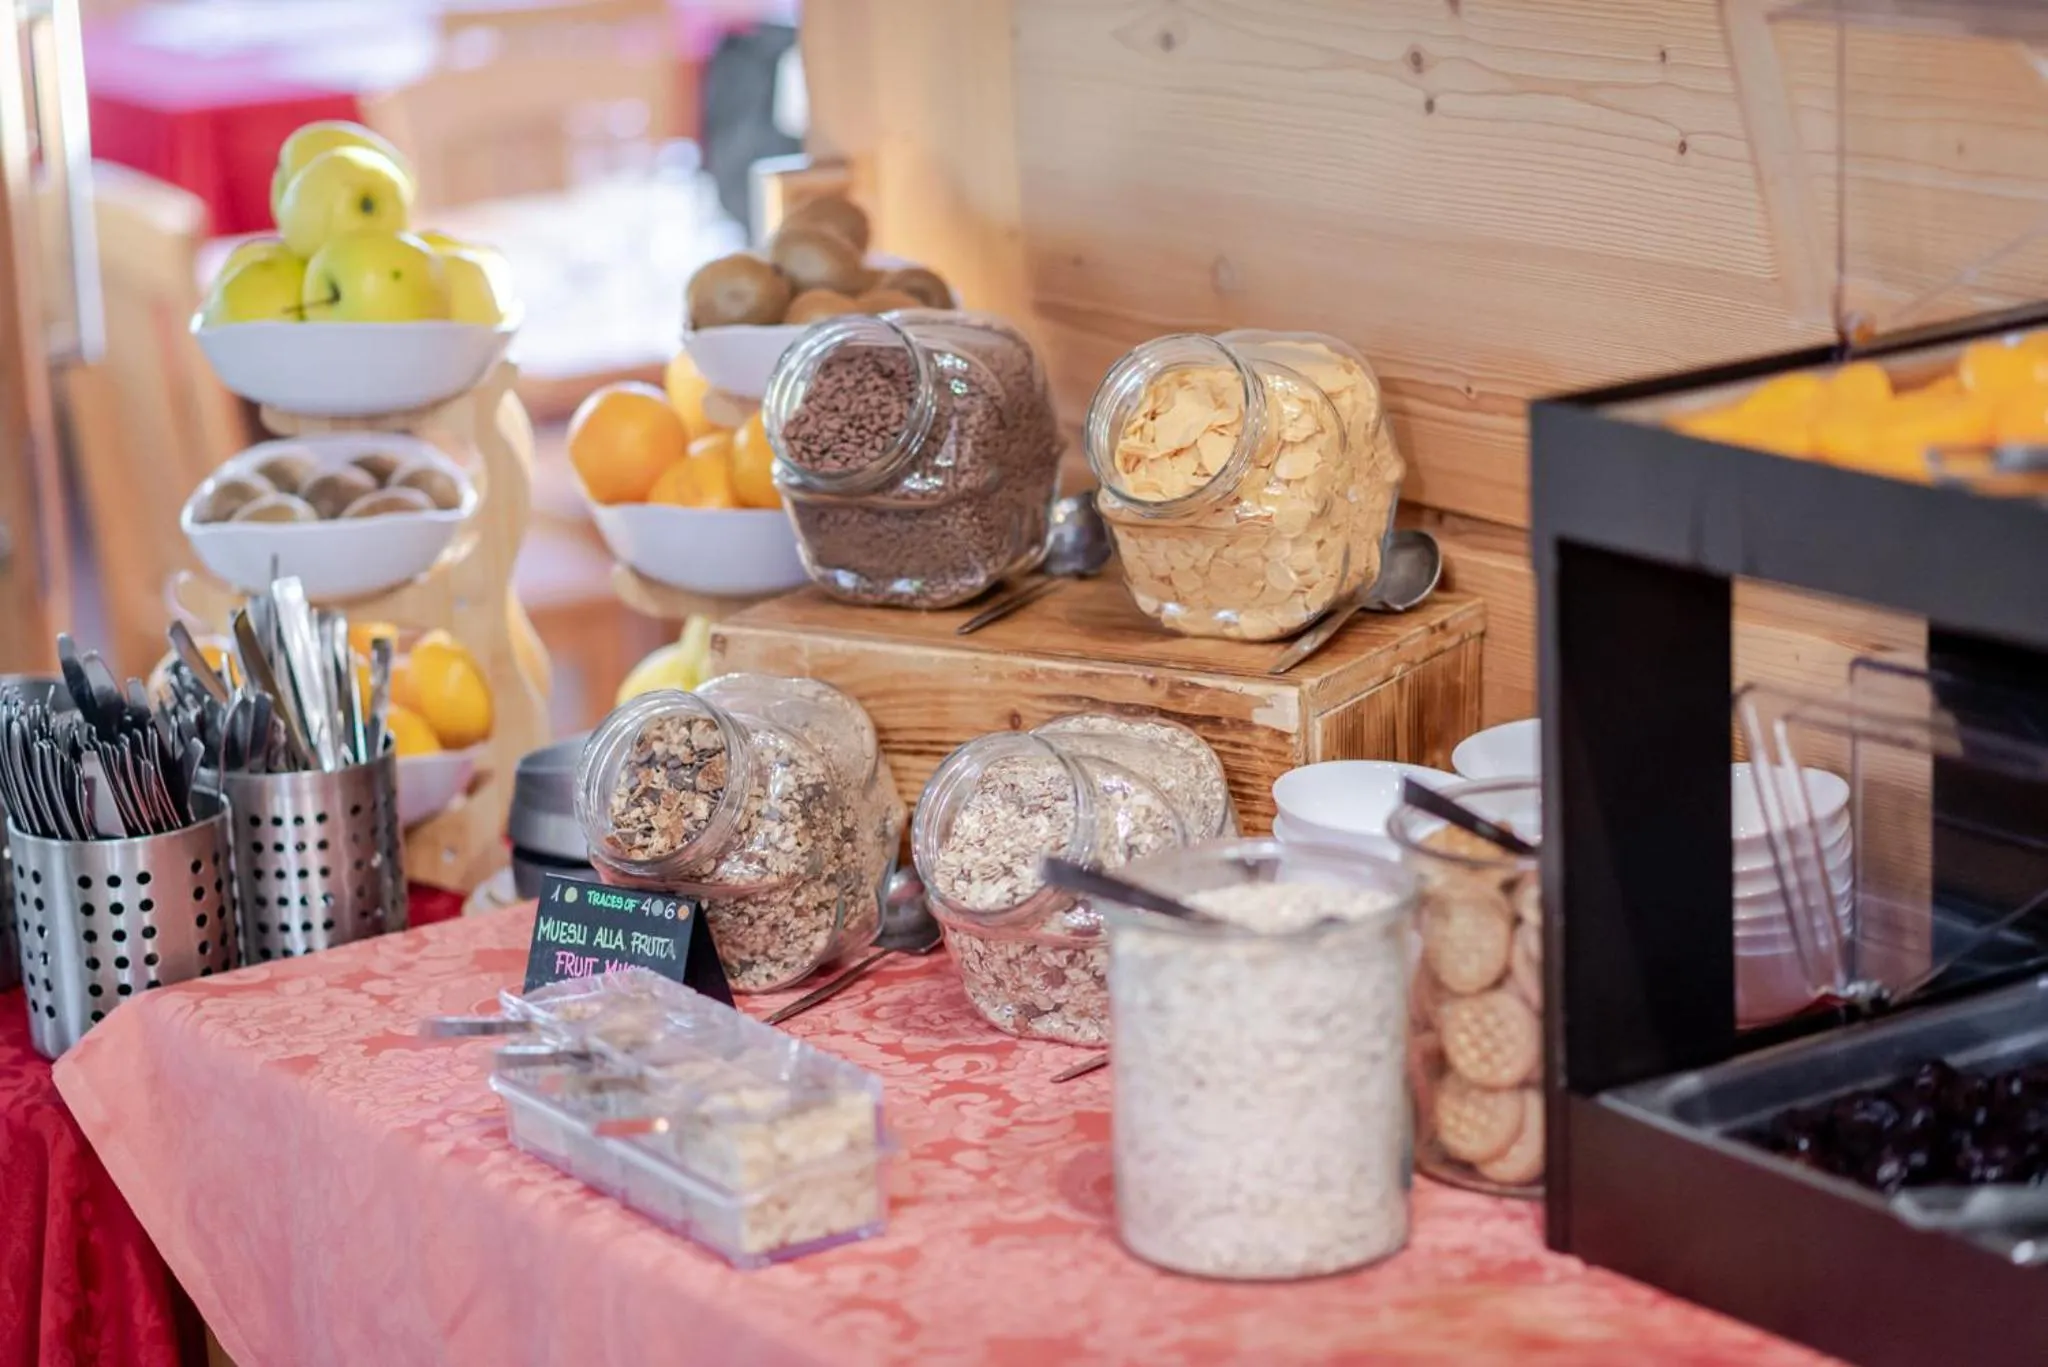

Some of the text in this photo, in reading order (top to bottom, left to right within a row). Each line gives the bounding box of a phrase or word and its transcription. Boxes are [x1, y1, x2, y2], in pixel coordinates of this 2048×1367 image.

[587, 890, 624, 909] TRACES
[624, 899, 638, 912] OF
[641, 896, 652, 917] 4
[664, 902, 676, 920] 6
[537, 916, 676, 960] MUESLI ALLA FRUTTA
[555, 951, 599, 977] FRUIT
